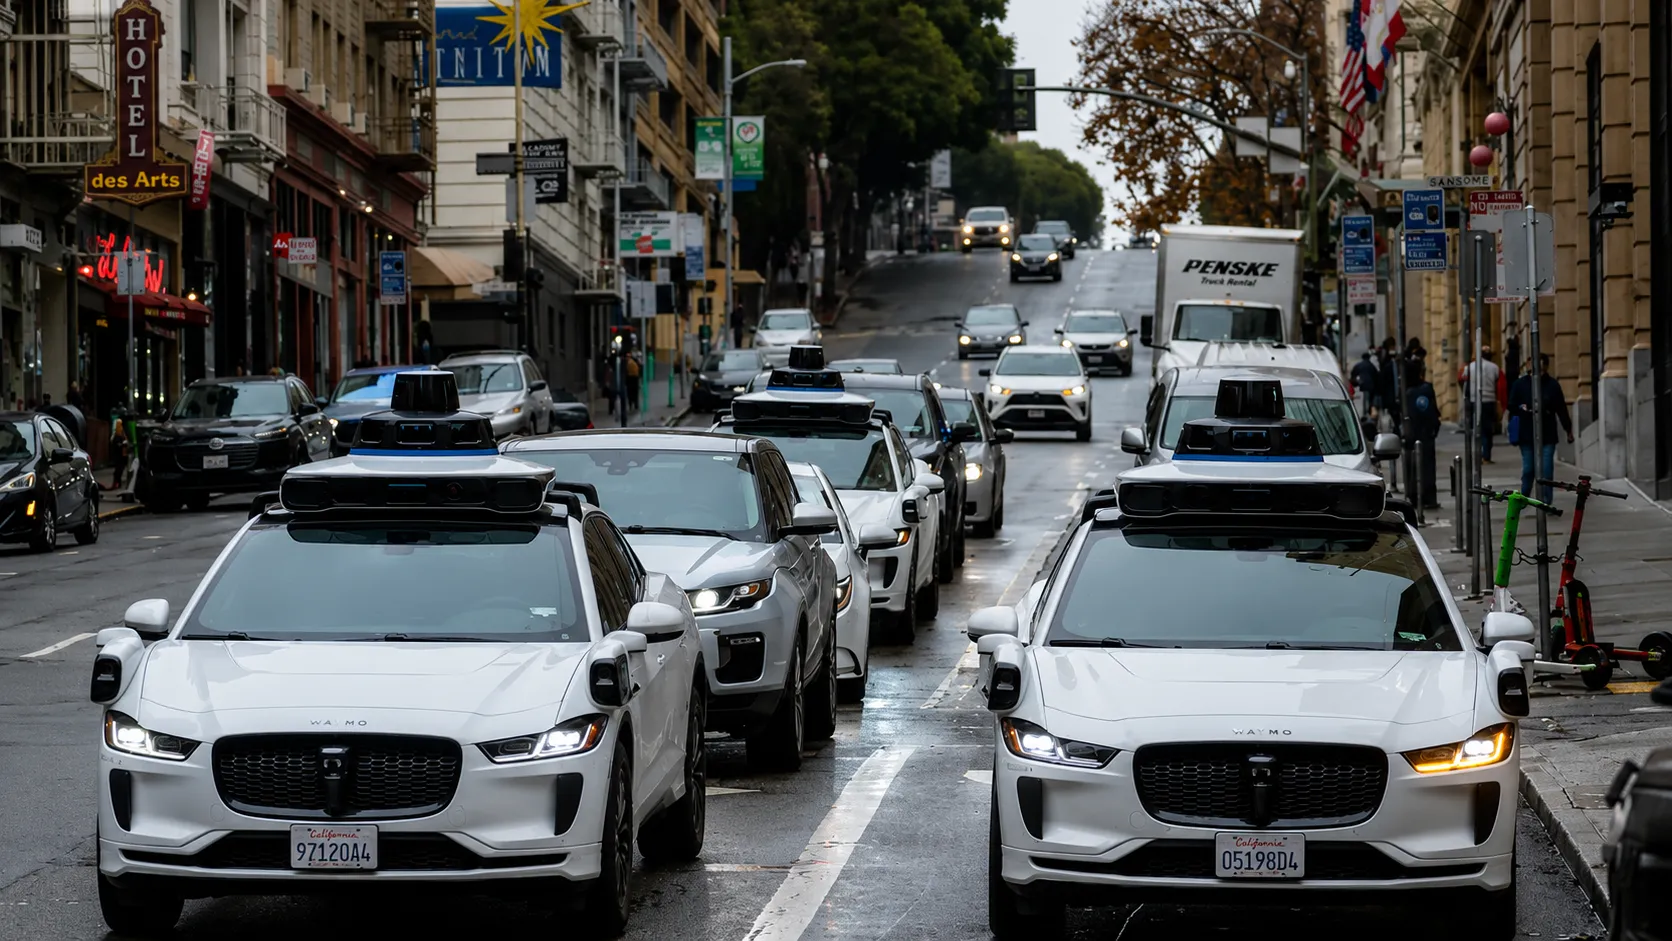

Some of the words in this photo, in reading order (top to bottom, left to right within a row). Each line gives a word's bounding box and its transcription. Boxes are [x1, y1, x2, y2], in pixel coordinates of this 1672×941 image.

[125, 18, 147, 157] HOTEL
[91, 173, 128, 189] des
[134, 171, 180, 188] Arts
[1429, 176, 1489, 187] SANSOME
[1182, 259, 1280, 277] PENSKE
[1201, 277, 1224, 286] Truck
[1226, 278, 1257, 287] Rental
[297, 842, 371, 862] 97120A4
[1222, 850, 1299, 871] 05198D4
